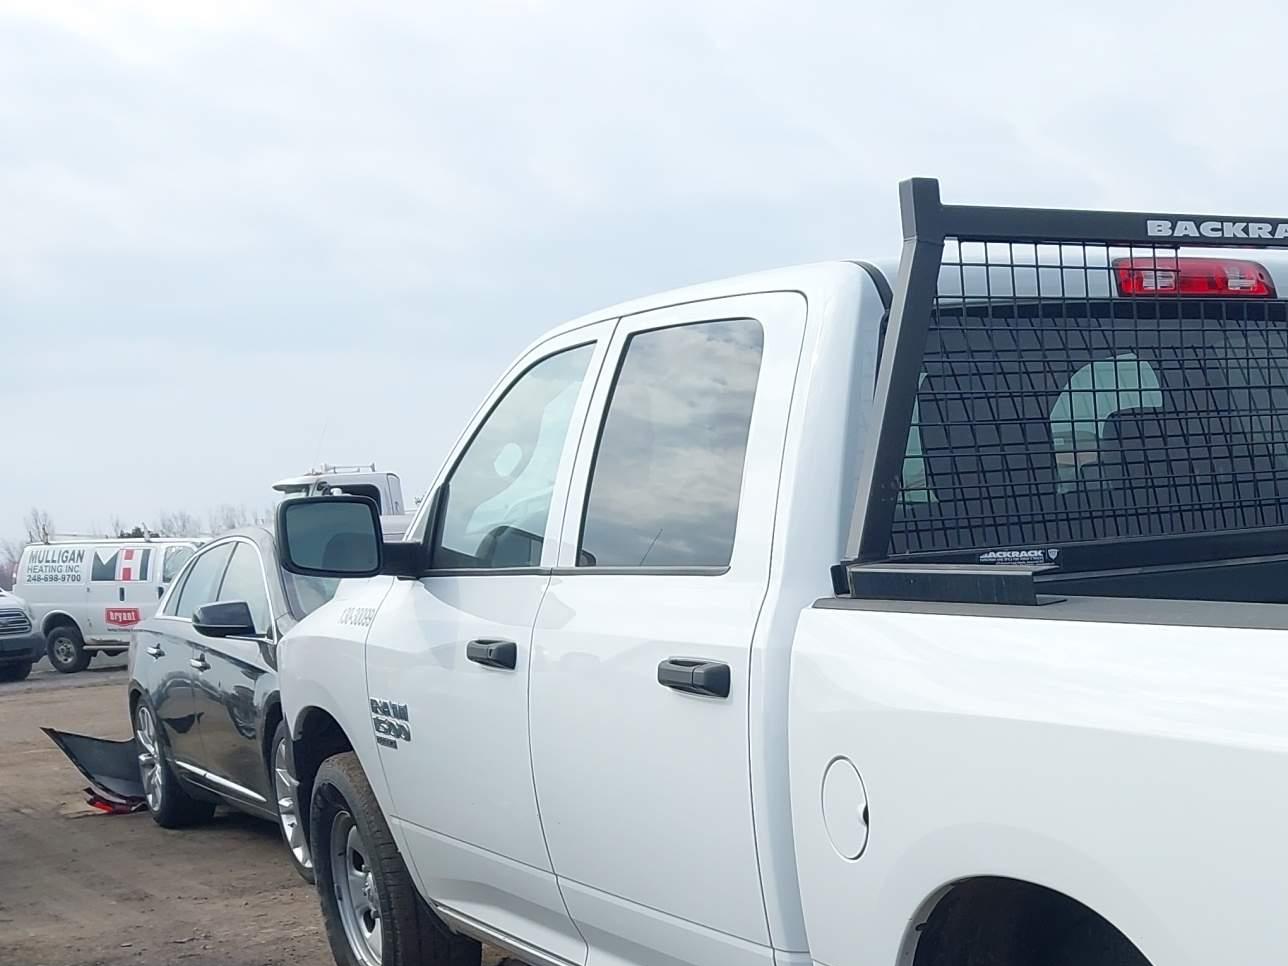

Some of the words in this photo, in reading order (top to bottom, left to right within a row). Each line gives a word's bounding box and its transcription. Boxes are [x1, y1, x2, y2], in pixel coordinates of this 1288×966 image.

[29, 550, 85, 563] MULLIGAN
[27, 565, 62, 573] HEATING
[65, 565, 80, 573] INC
[109, 611, 136, 622] bryant
